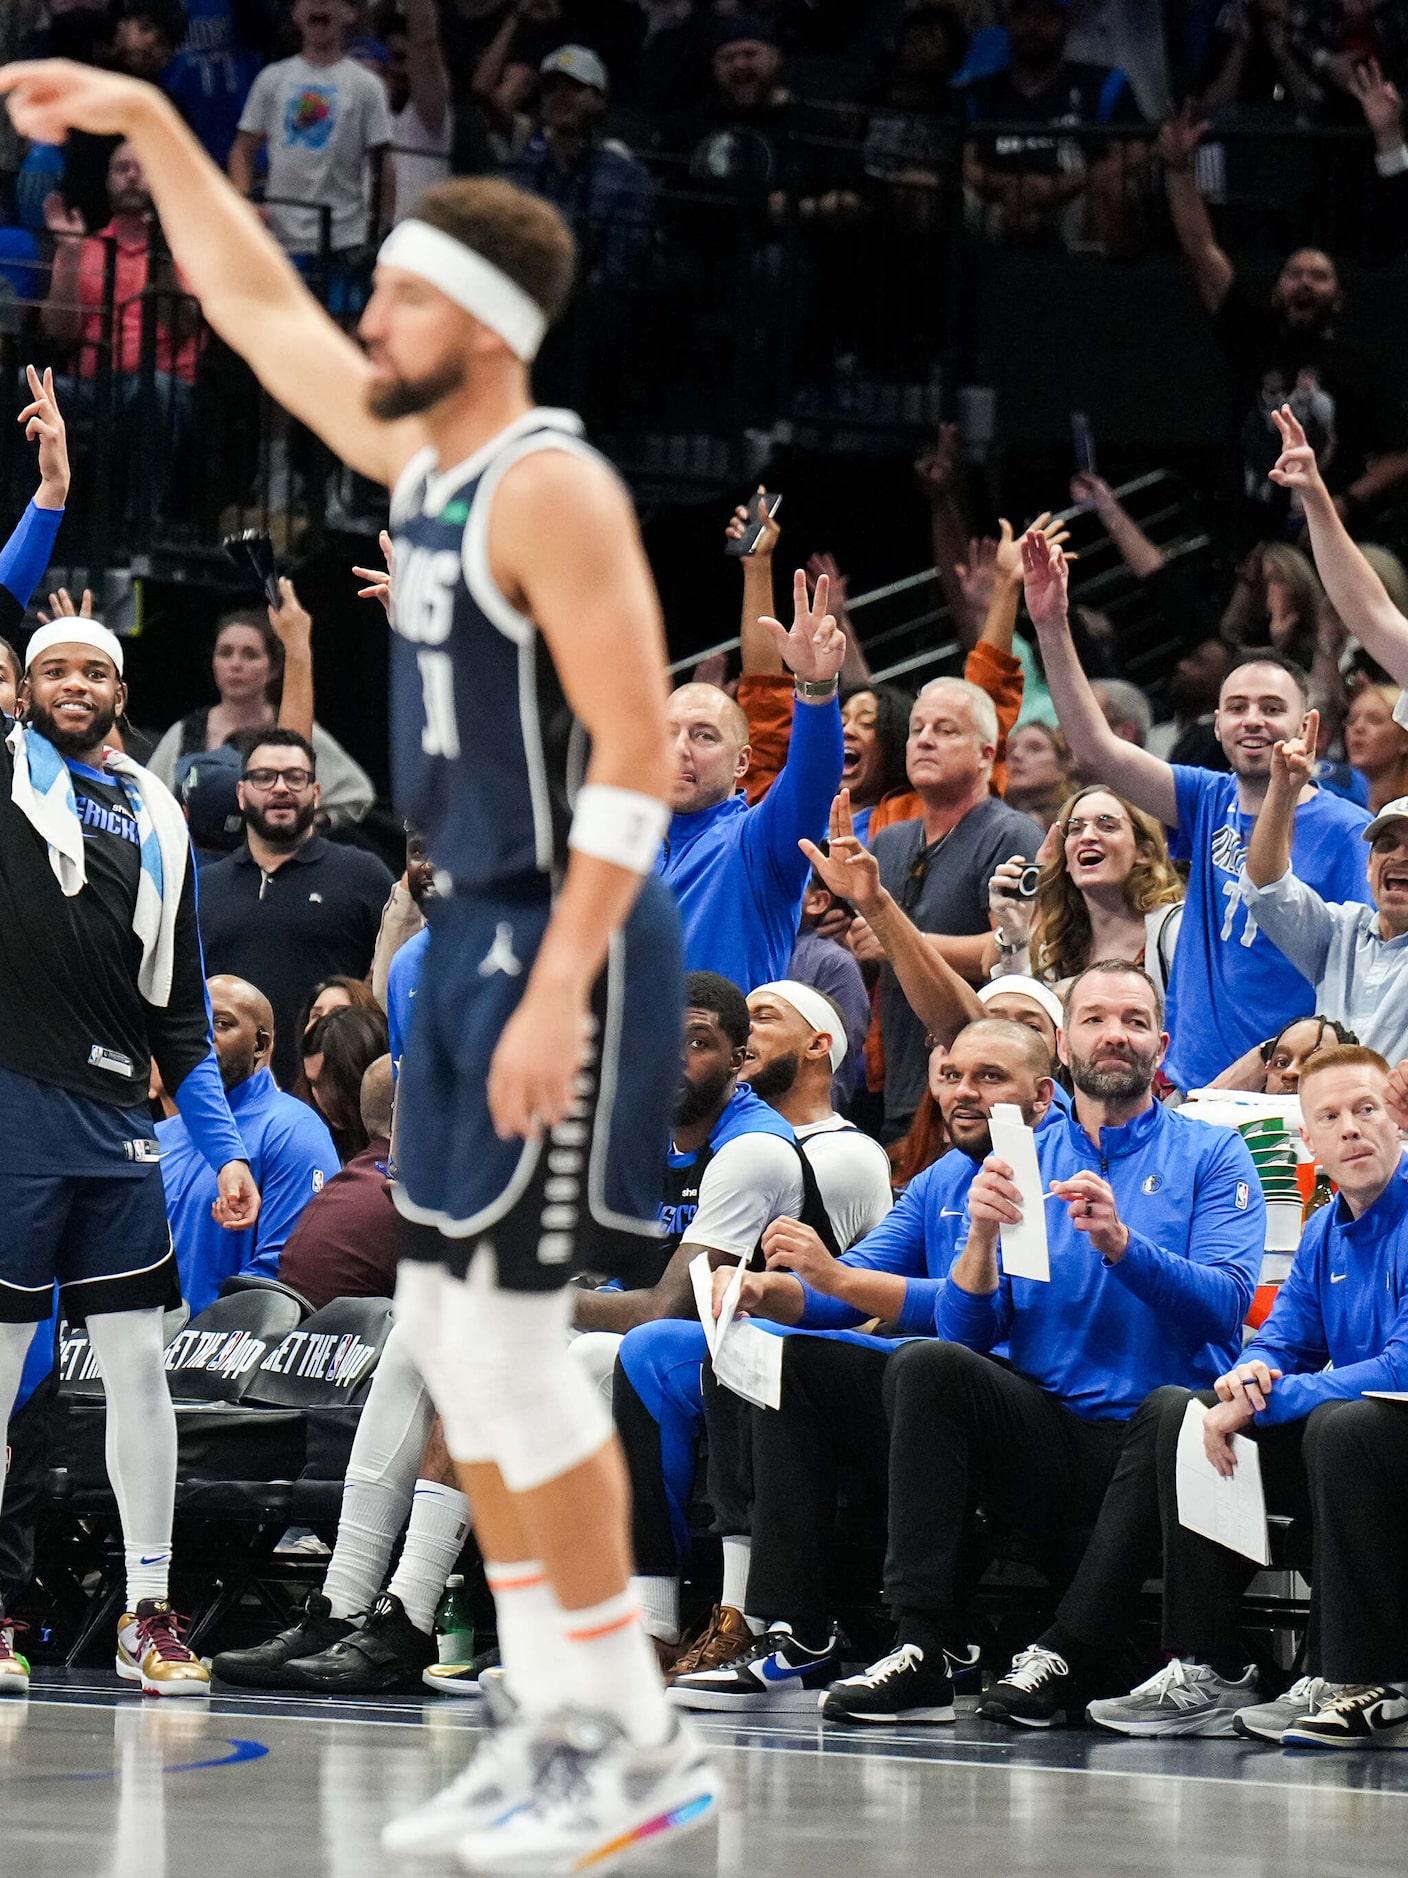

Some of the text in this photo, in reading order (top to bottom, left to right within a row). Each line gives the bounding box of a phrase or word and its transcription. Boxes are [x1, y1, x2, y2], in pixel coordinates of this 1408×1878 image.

[75, 796, 140, 847] ERICK
[181, 1331, 229, 1369] THE
[259, 1331, 376, 1388] GET THE App
